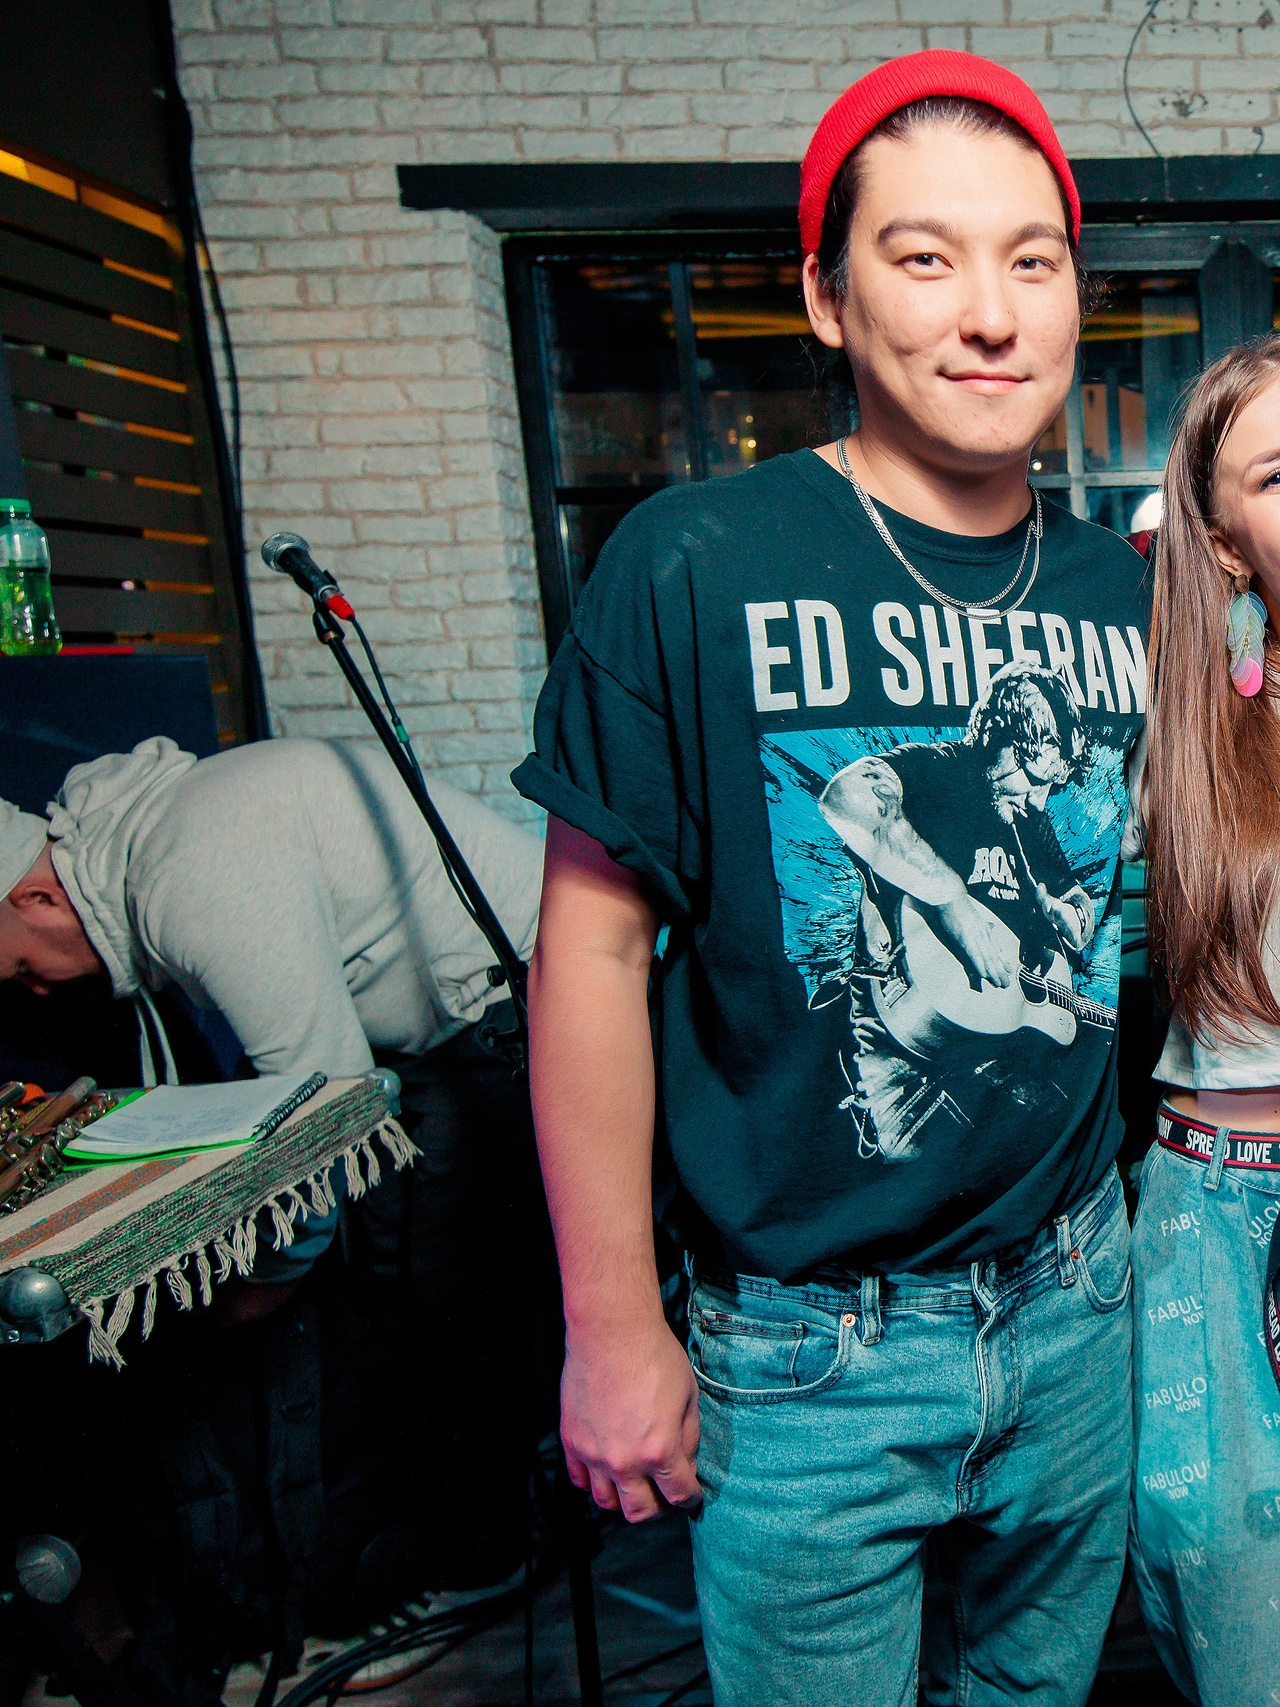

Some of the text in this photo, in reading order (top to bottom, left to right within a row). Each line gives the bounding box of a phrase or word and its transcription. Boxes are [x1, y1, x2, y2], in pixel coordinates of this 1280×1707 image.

[745, 600, 1147, 713] ED SHEERAN
[1185, 1128, 1231, 1160] SPRED
[1236, 1141, 1272, 1164] LOVE
[1147, 1293, 1203, 1326] FABUL
[1175, 1397, 1200, 1413] NOW
[1168, 1485, 1189, 1500] NOW
